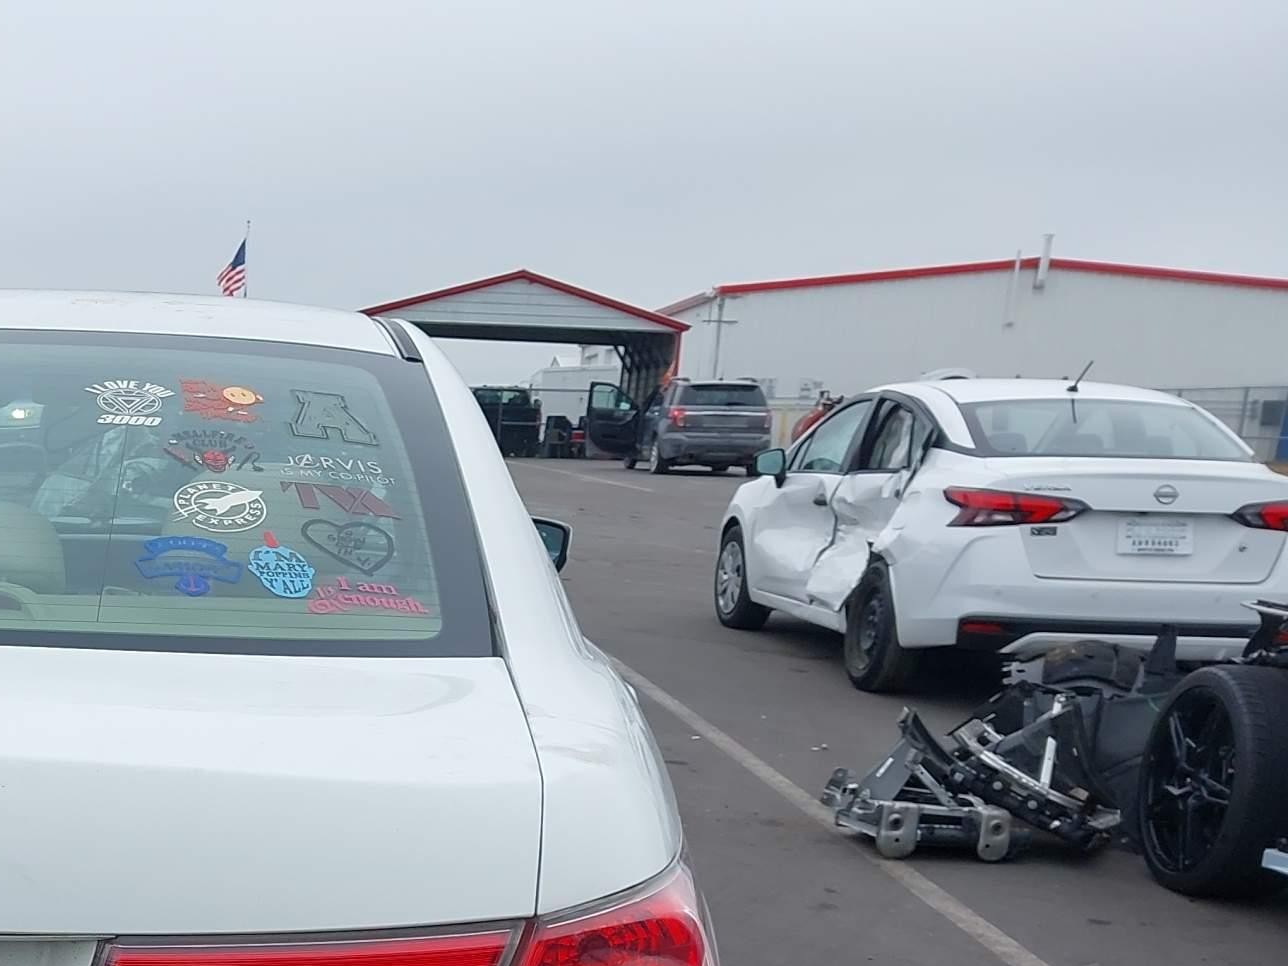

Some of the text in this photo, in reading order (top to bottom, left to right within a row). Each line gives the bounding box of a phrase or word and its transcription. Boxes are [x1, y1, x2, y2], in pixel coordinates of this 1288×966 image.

[92, 380, 140, 393] LOVE
[142, 382, 177, 398] YOU
[97, 414, 162, 427] 3000
[287, 454, 383, 475] JARVIS
[300, 469, 323, 478] MY
[178, 481, 239, 506] PLANET
[196, 502, 263, 527] EXPRESS
[252, 549, 306, 563] I'M
[253, 561, 307, 573] MARY
[259, 570, 310, 579] POPPINS
[264, 577, 310, 595] Y'ALL
[337, 575, 399, 597] I am
